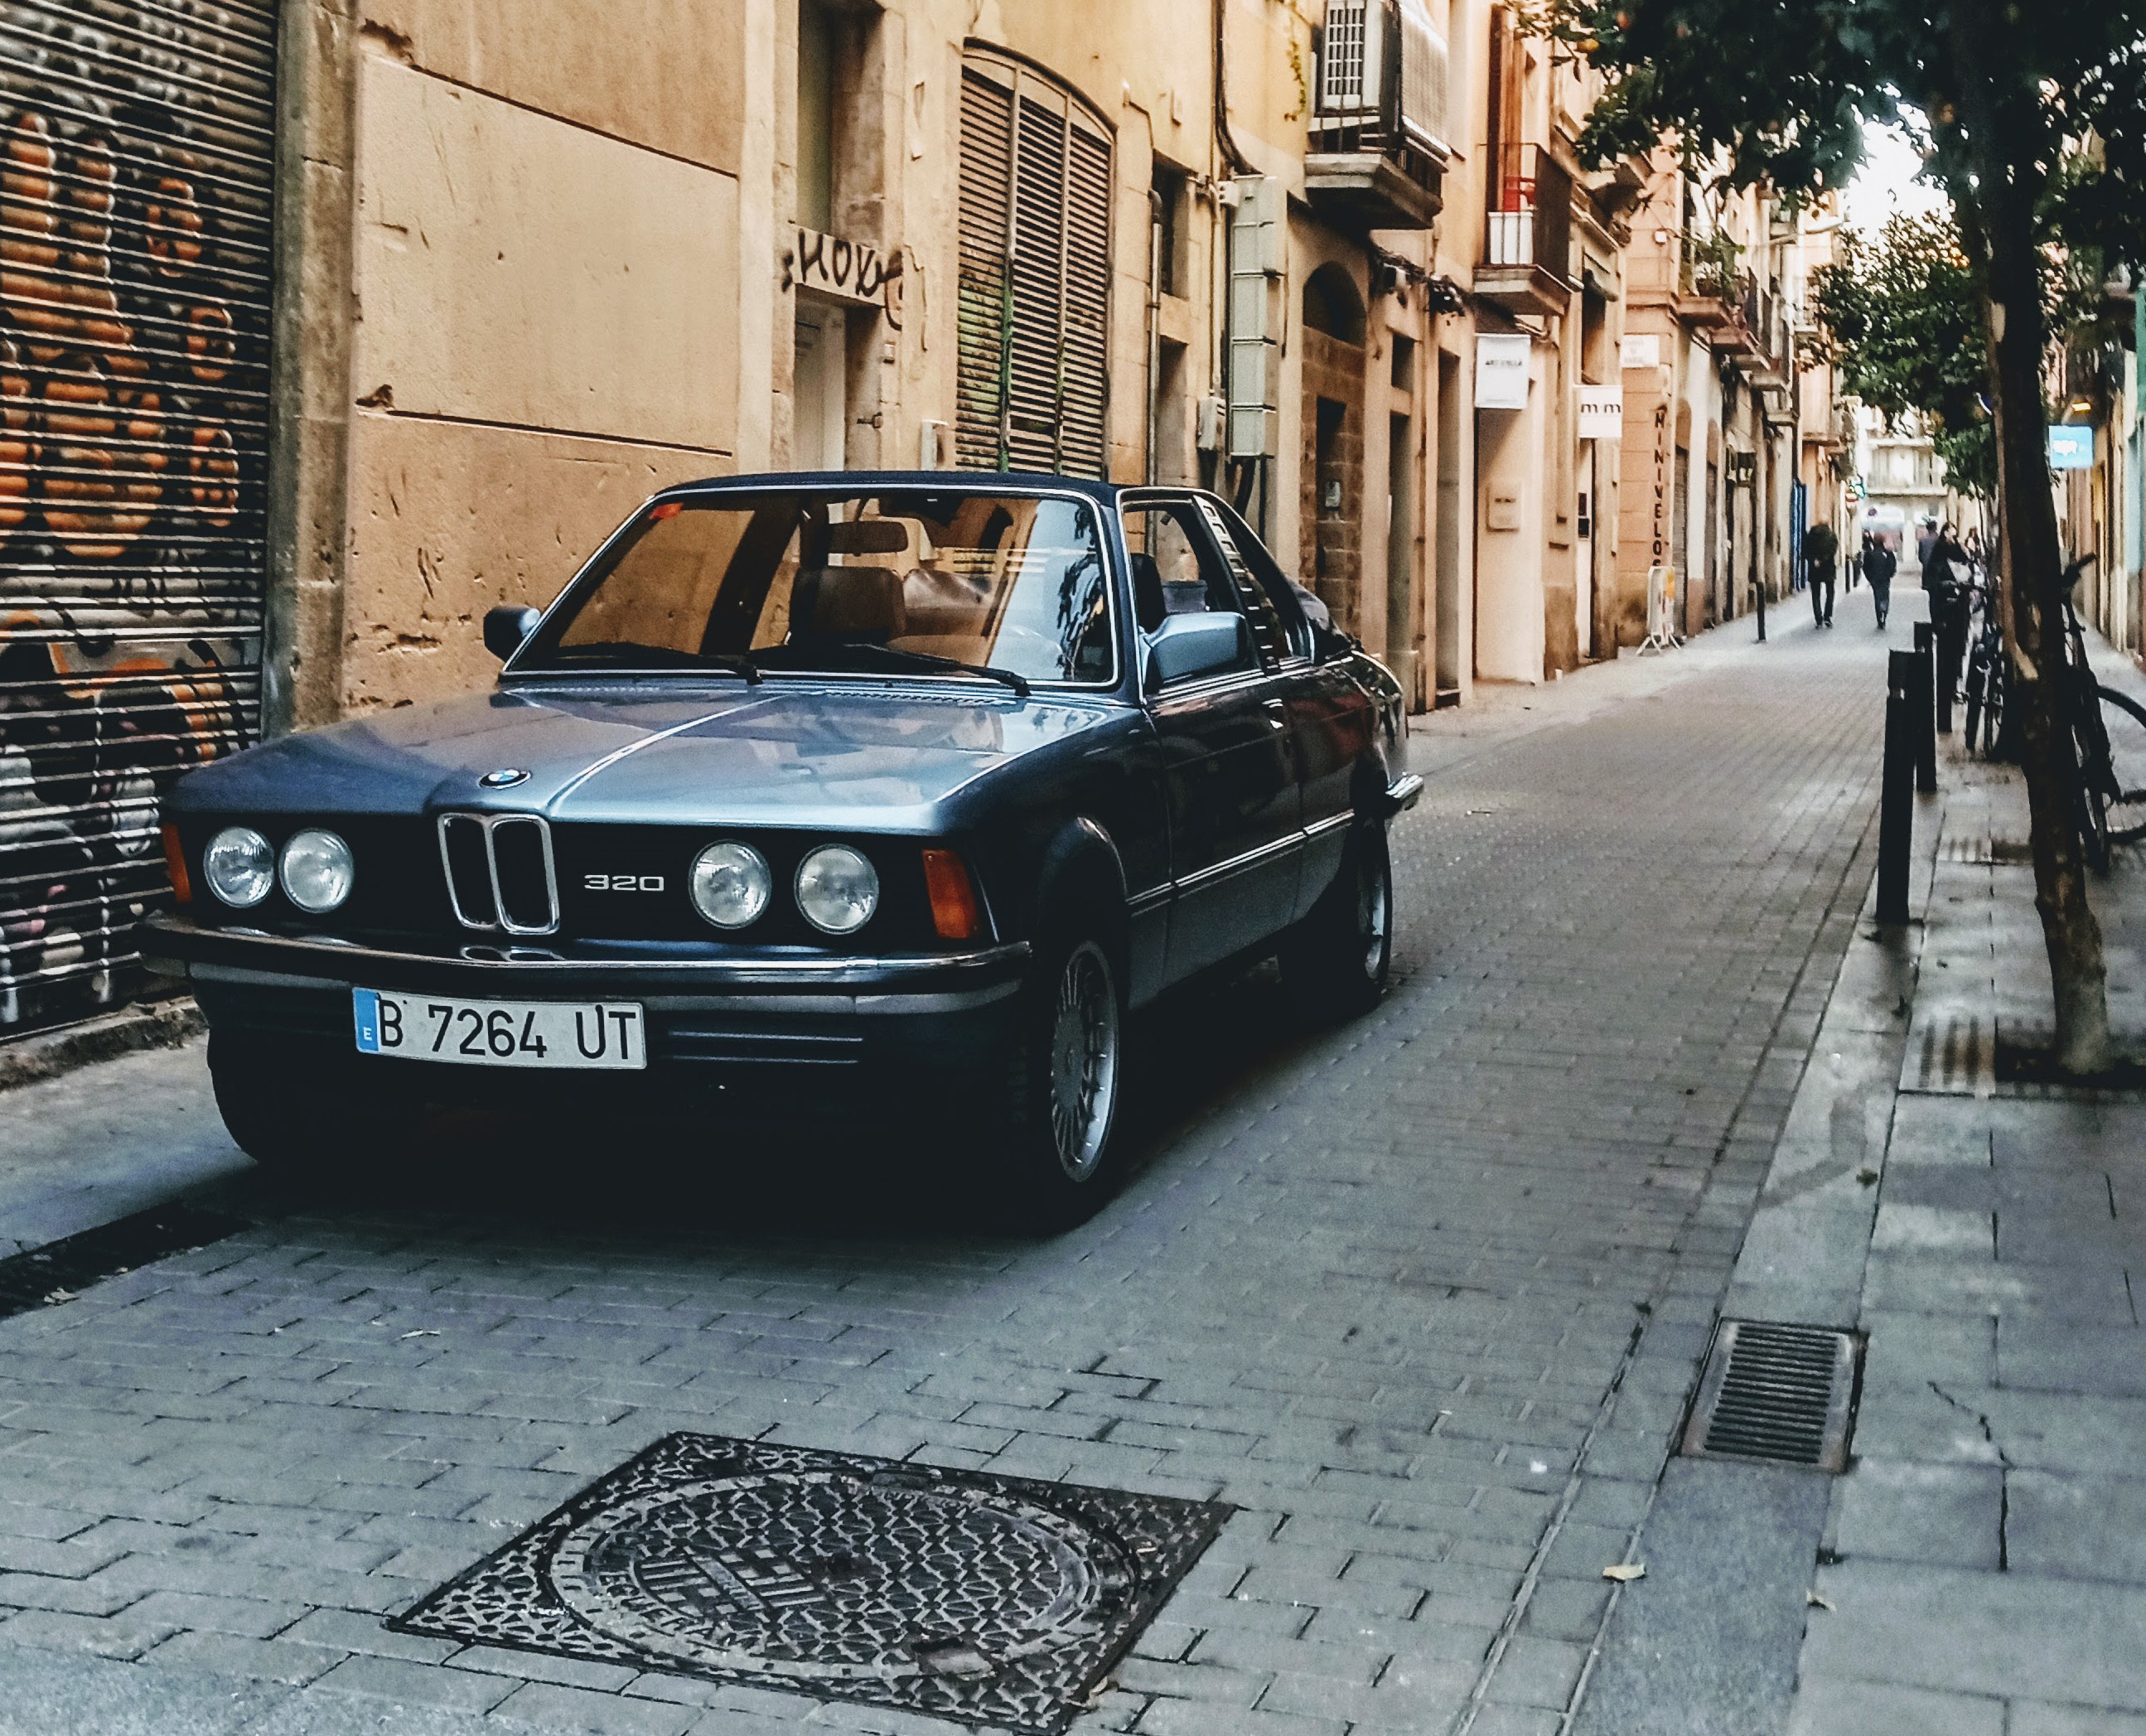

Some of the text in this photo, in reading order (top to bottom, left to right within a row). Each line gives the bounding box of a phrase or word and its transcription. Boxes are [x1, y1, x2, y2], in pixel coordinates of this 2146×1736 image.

[584, 874, 665, 891] 320
[363, 1026, 372, 1041] E
[379, 999, 637, 1060] B 7264 UT
